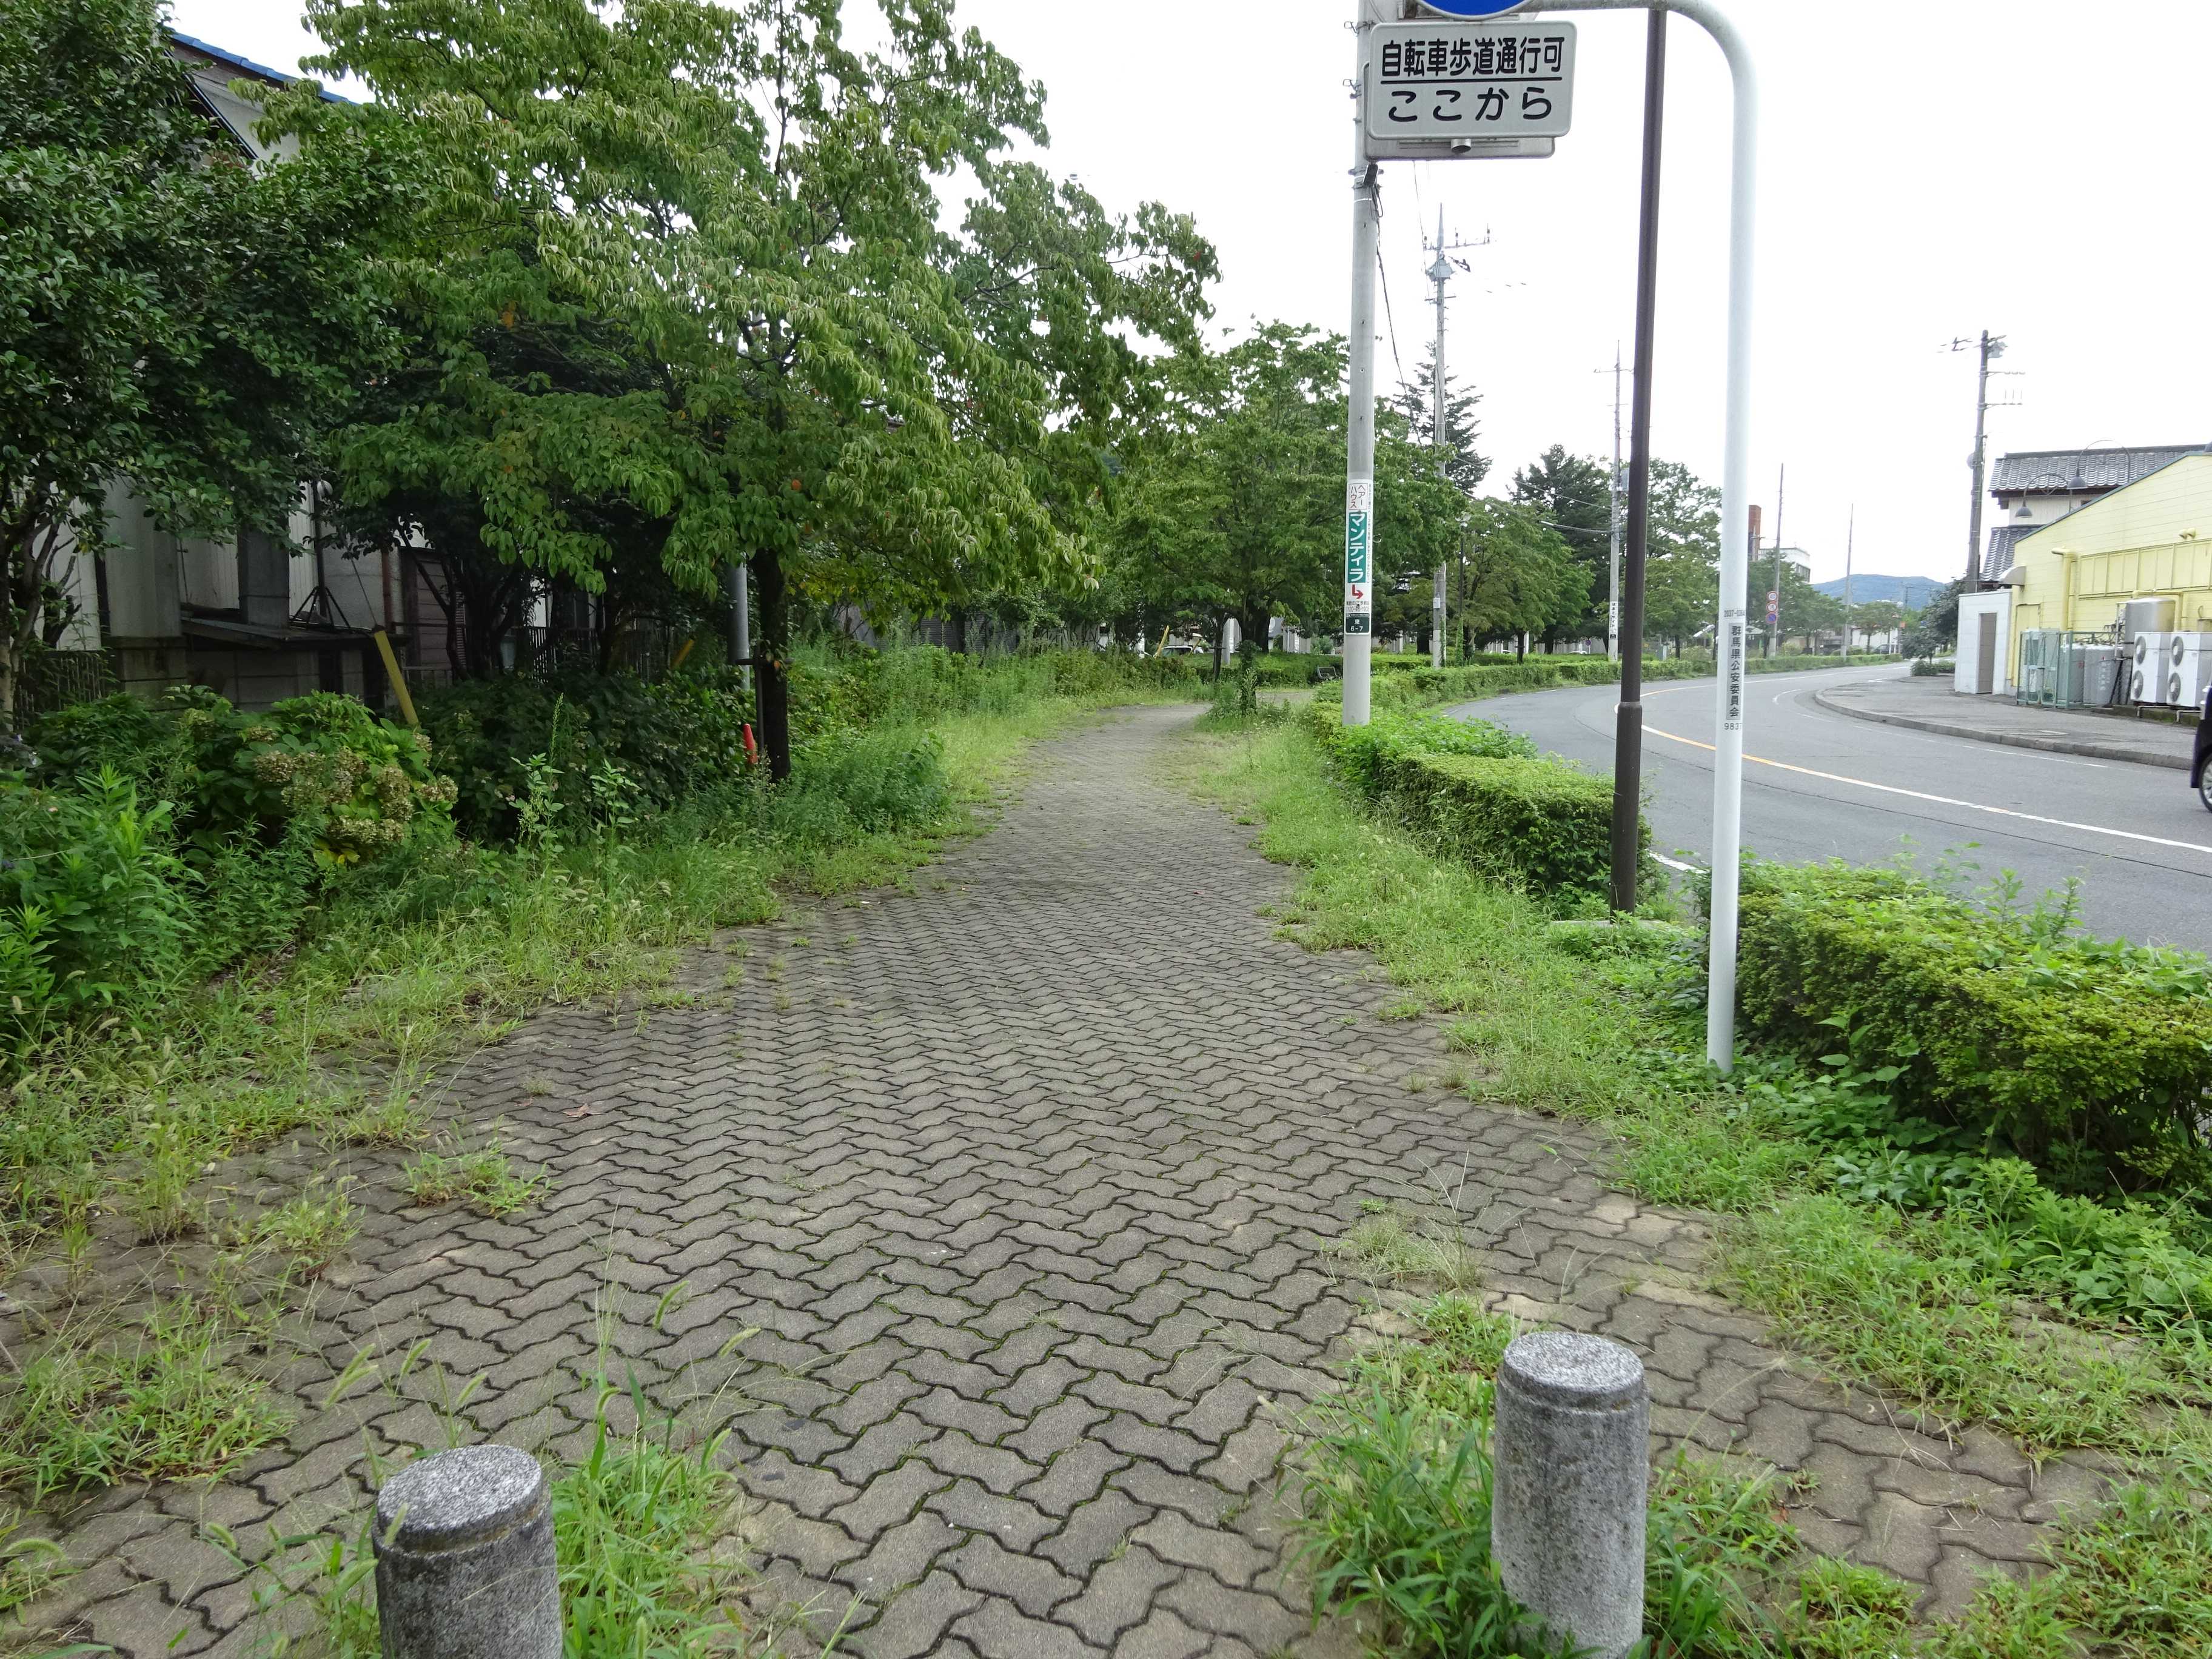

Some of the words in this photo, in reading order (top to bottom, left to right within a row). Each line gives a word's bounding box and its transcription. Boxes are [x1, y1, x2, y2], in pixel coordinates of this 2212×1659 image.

[1382, 37, 1564, 76] 自転車歩道通行可
[1388, 87, 1552, 122] ここから
[1358, 484, 1366, 506] ヘアー
[1349, 513, 1366, 582] マンティラ
[1729, 625, 1741, 717] 群馬県公安委員会
